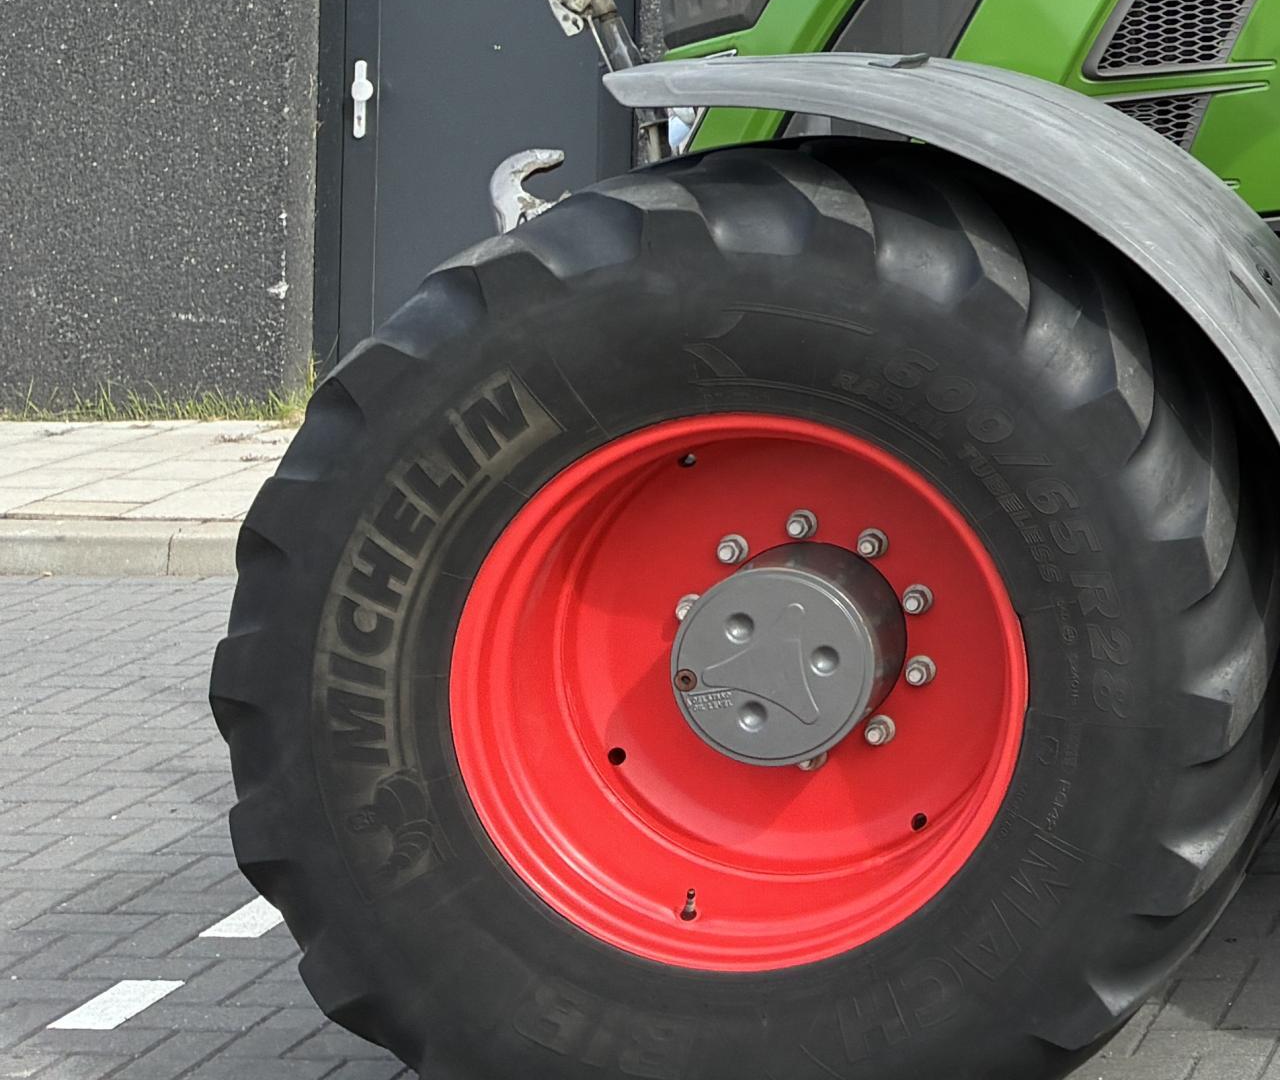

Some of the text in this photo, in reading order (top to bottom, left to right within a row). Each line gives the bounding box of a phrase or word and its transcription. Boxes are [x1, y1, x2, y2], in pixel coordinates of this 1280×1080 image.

[324, 381, 530, 767] MICHELIN
[882, 347, 1134, 720] 600/65 R28
[958, 441, 1063, 584] TUBELESS
